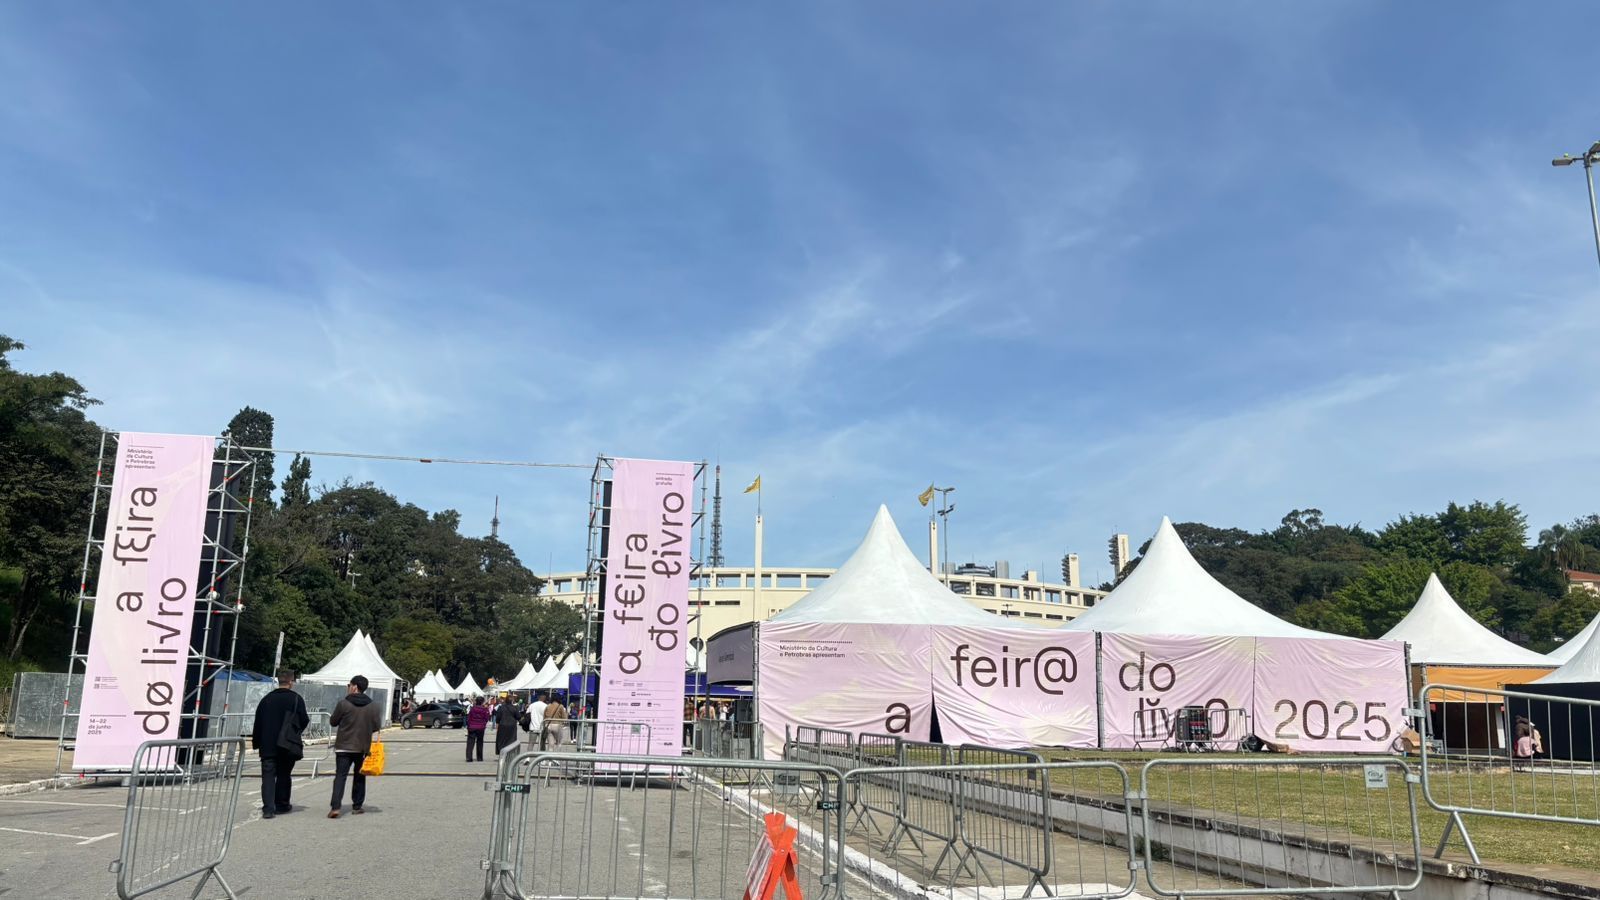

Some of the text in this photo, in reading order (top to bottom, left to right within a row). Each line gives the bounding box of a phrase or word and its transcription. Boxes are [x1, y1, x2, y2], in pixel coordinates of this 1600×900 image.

[116, 591, 144, 612] a
[950, 644, 1078, 695] feir@
[1119, 651, 1176, 692] do
[885, 702, 911, 734] a
[1274, 699, 1391, 742] 2025
